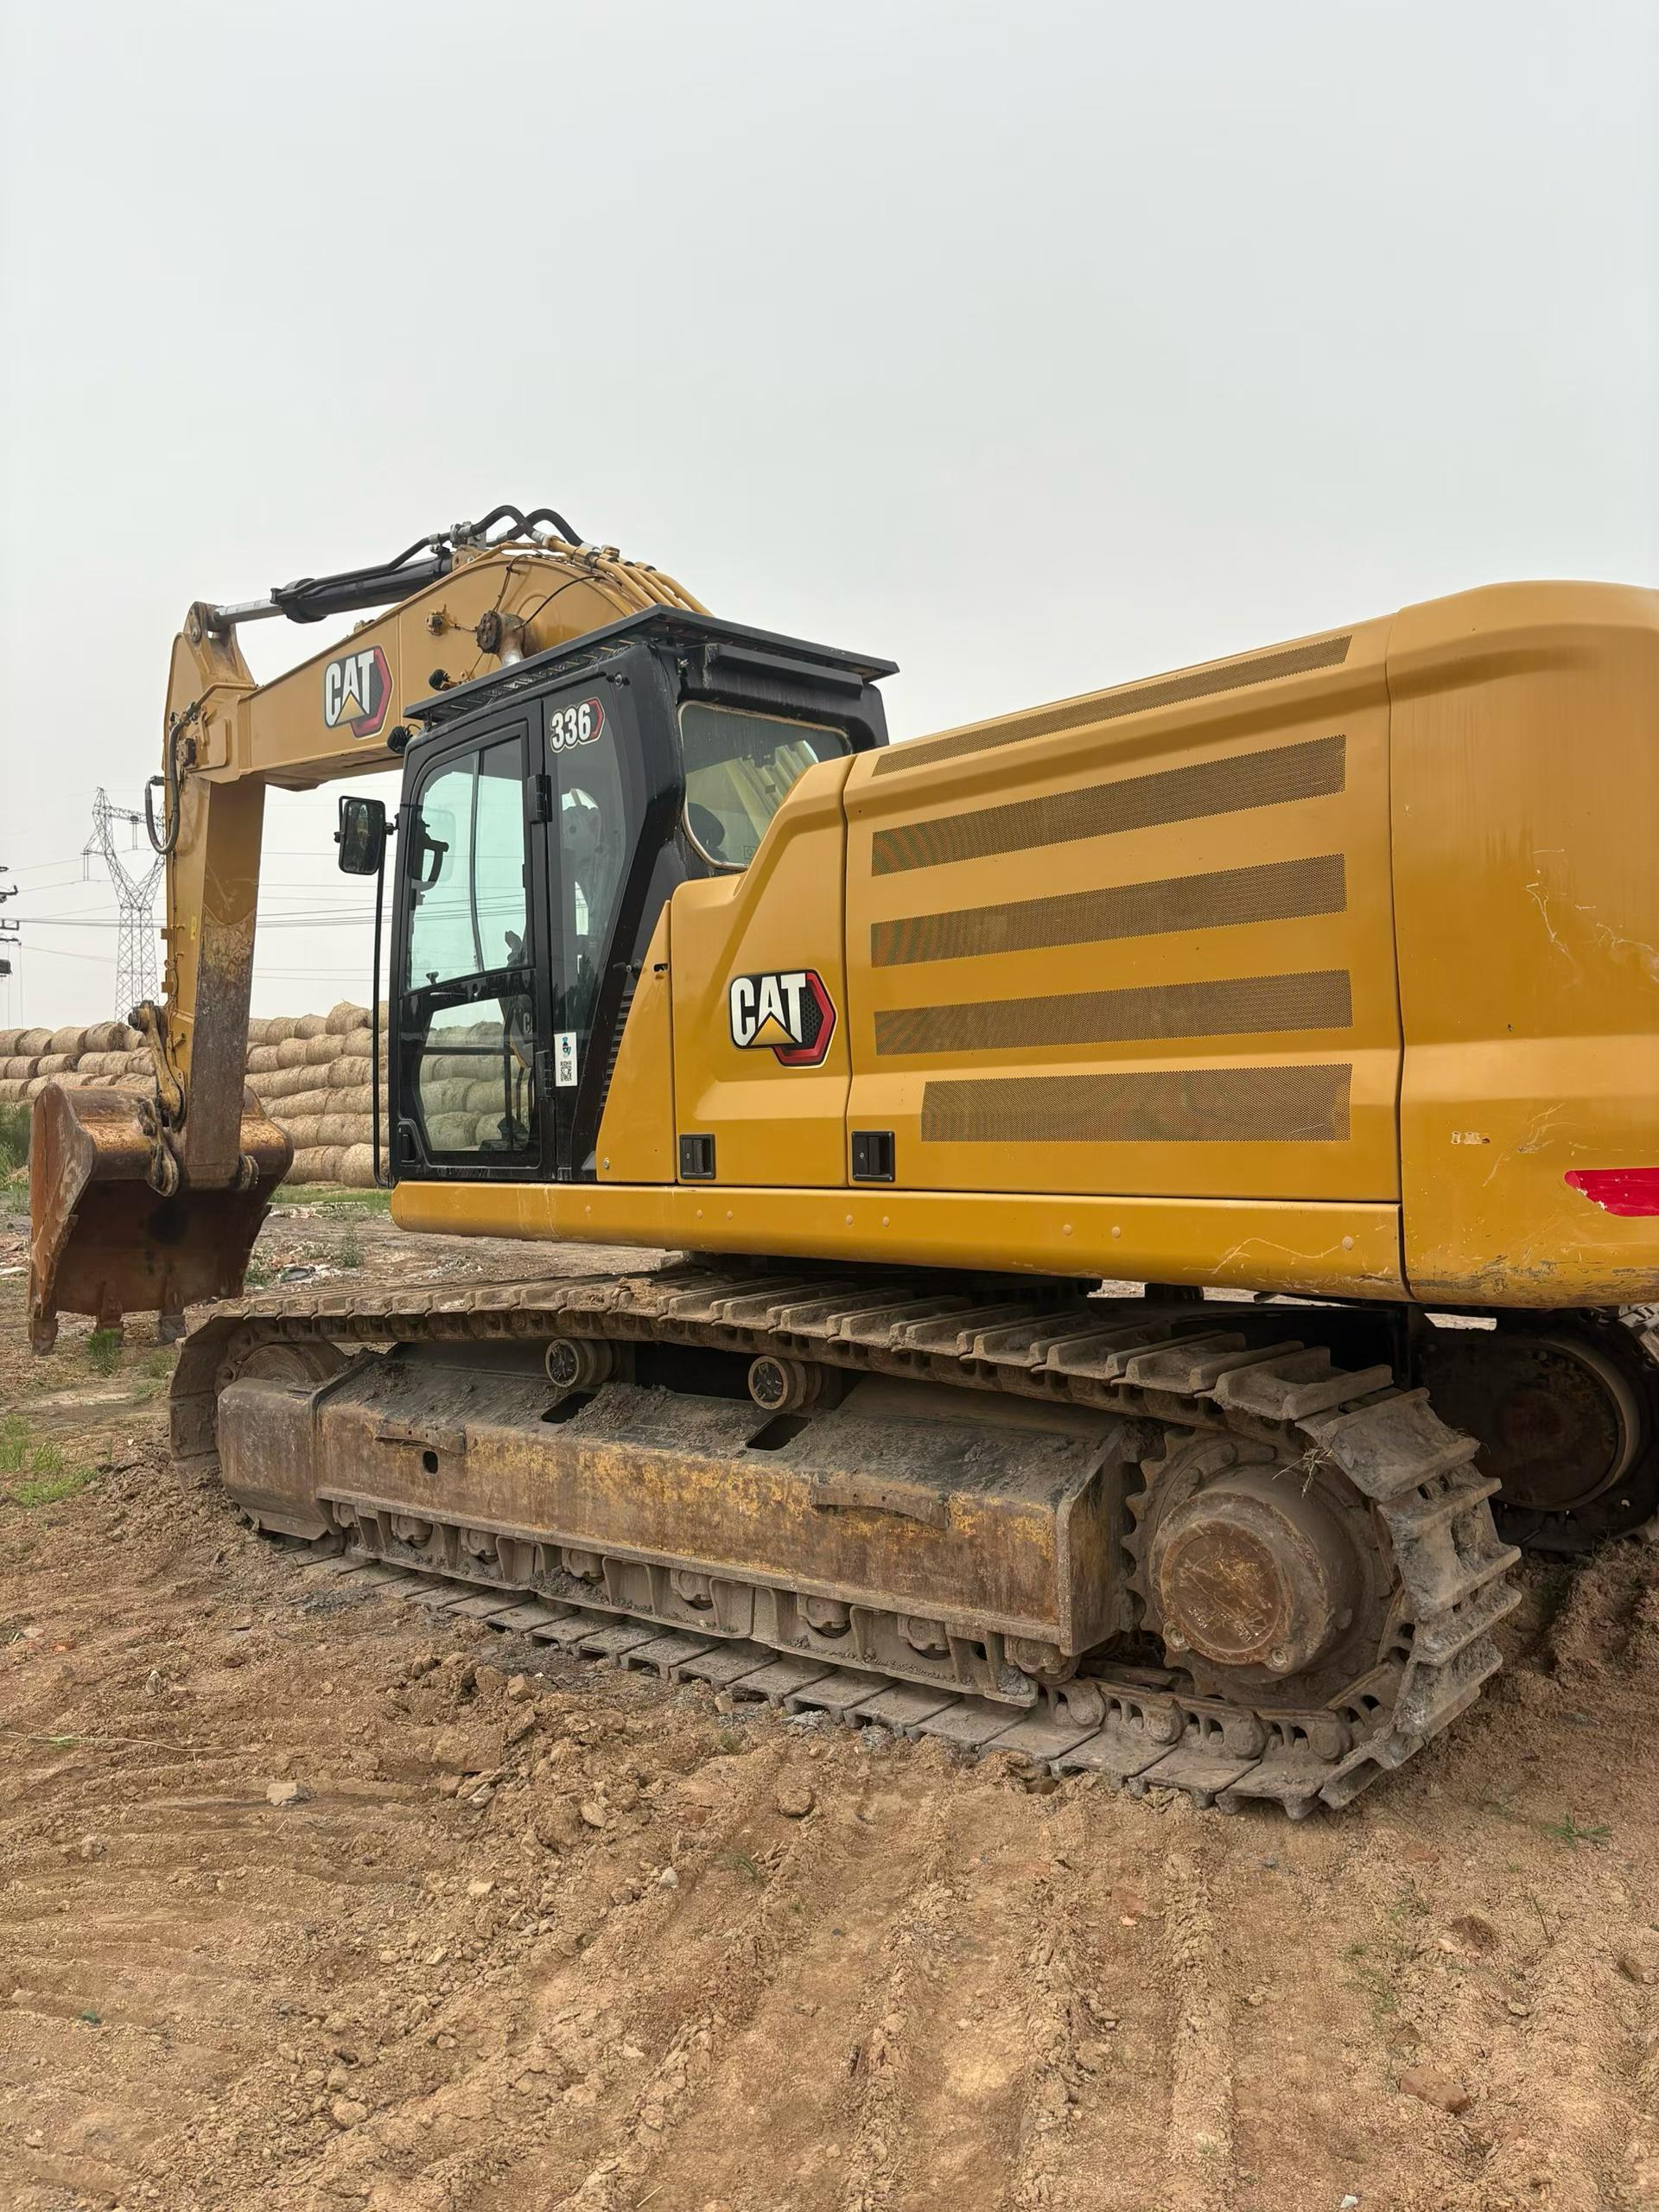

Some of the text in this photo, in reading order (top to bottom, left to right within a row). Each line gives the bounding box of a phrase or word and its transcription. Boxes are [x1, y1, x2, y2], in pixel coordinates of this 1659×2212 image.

[325, 650, 374, 727] CAT
[552, 703, 591, 749] 336
[731, 973, 806, 1046] CAT
